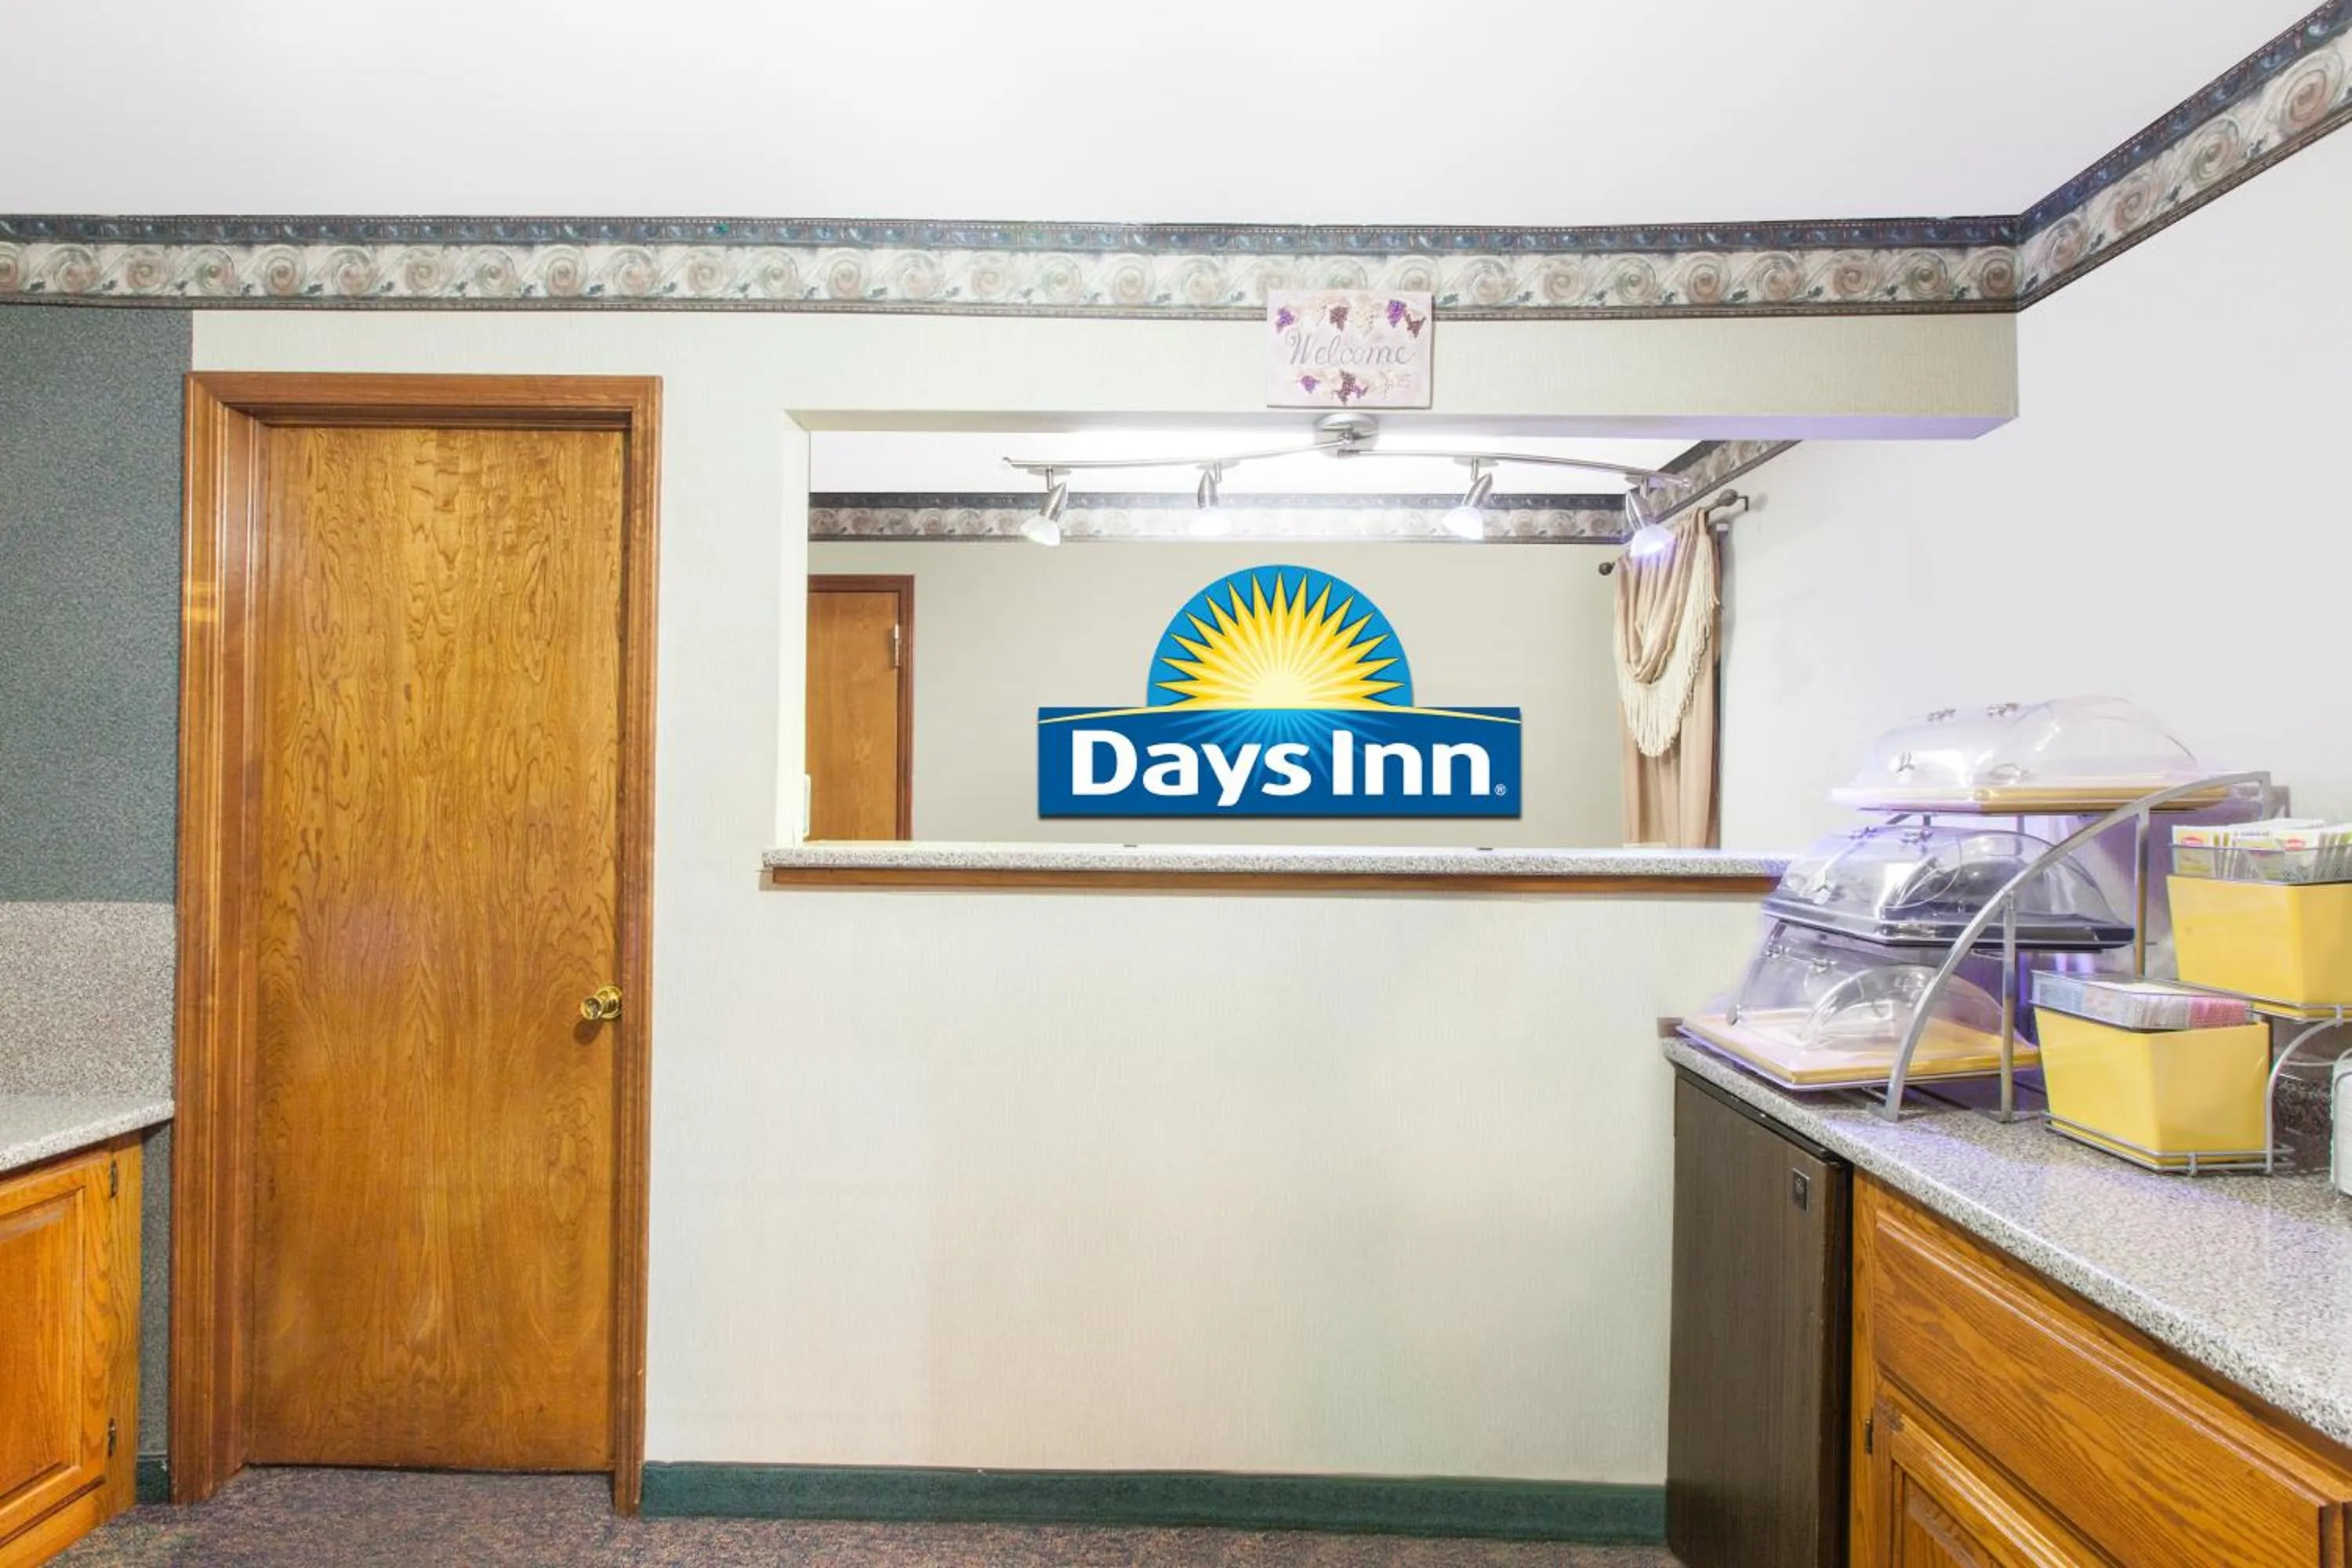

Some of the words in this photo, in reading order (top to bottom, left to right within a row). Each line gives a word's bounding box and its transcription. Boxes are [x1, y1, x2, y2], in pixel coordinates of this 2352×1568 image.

[1286, 329, 1415, 365] Welcome
[1072, 730, 1312, 806] Days
[1332, 730, 1490, 795] Inn
